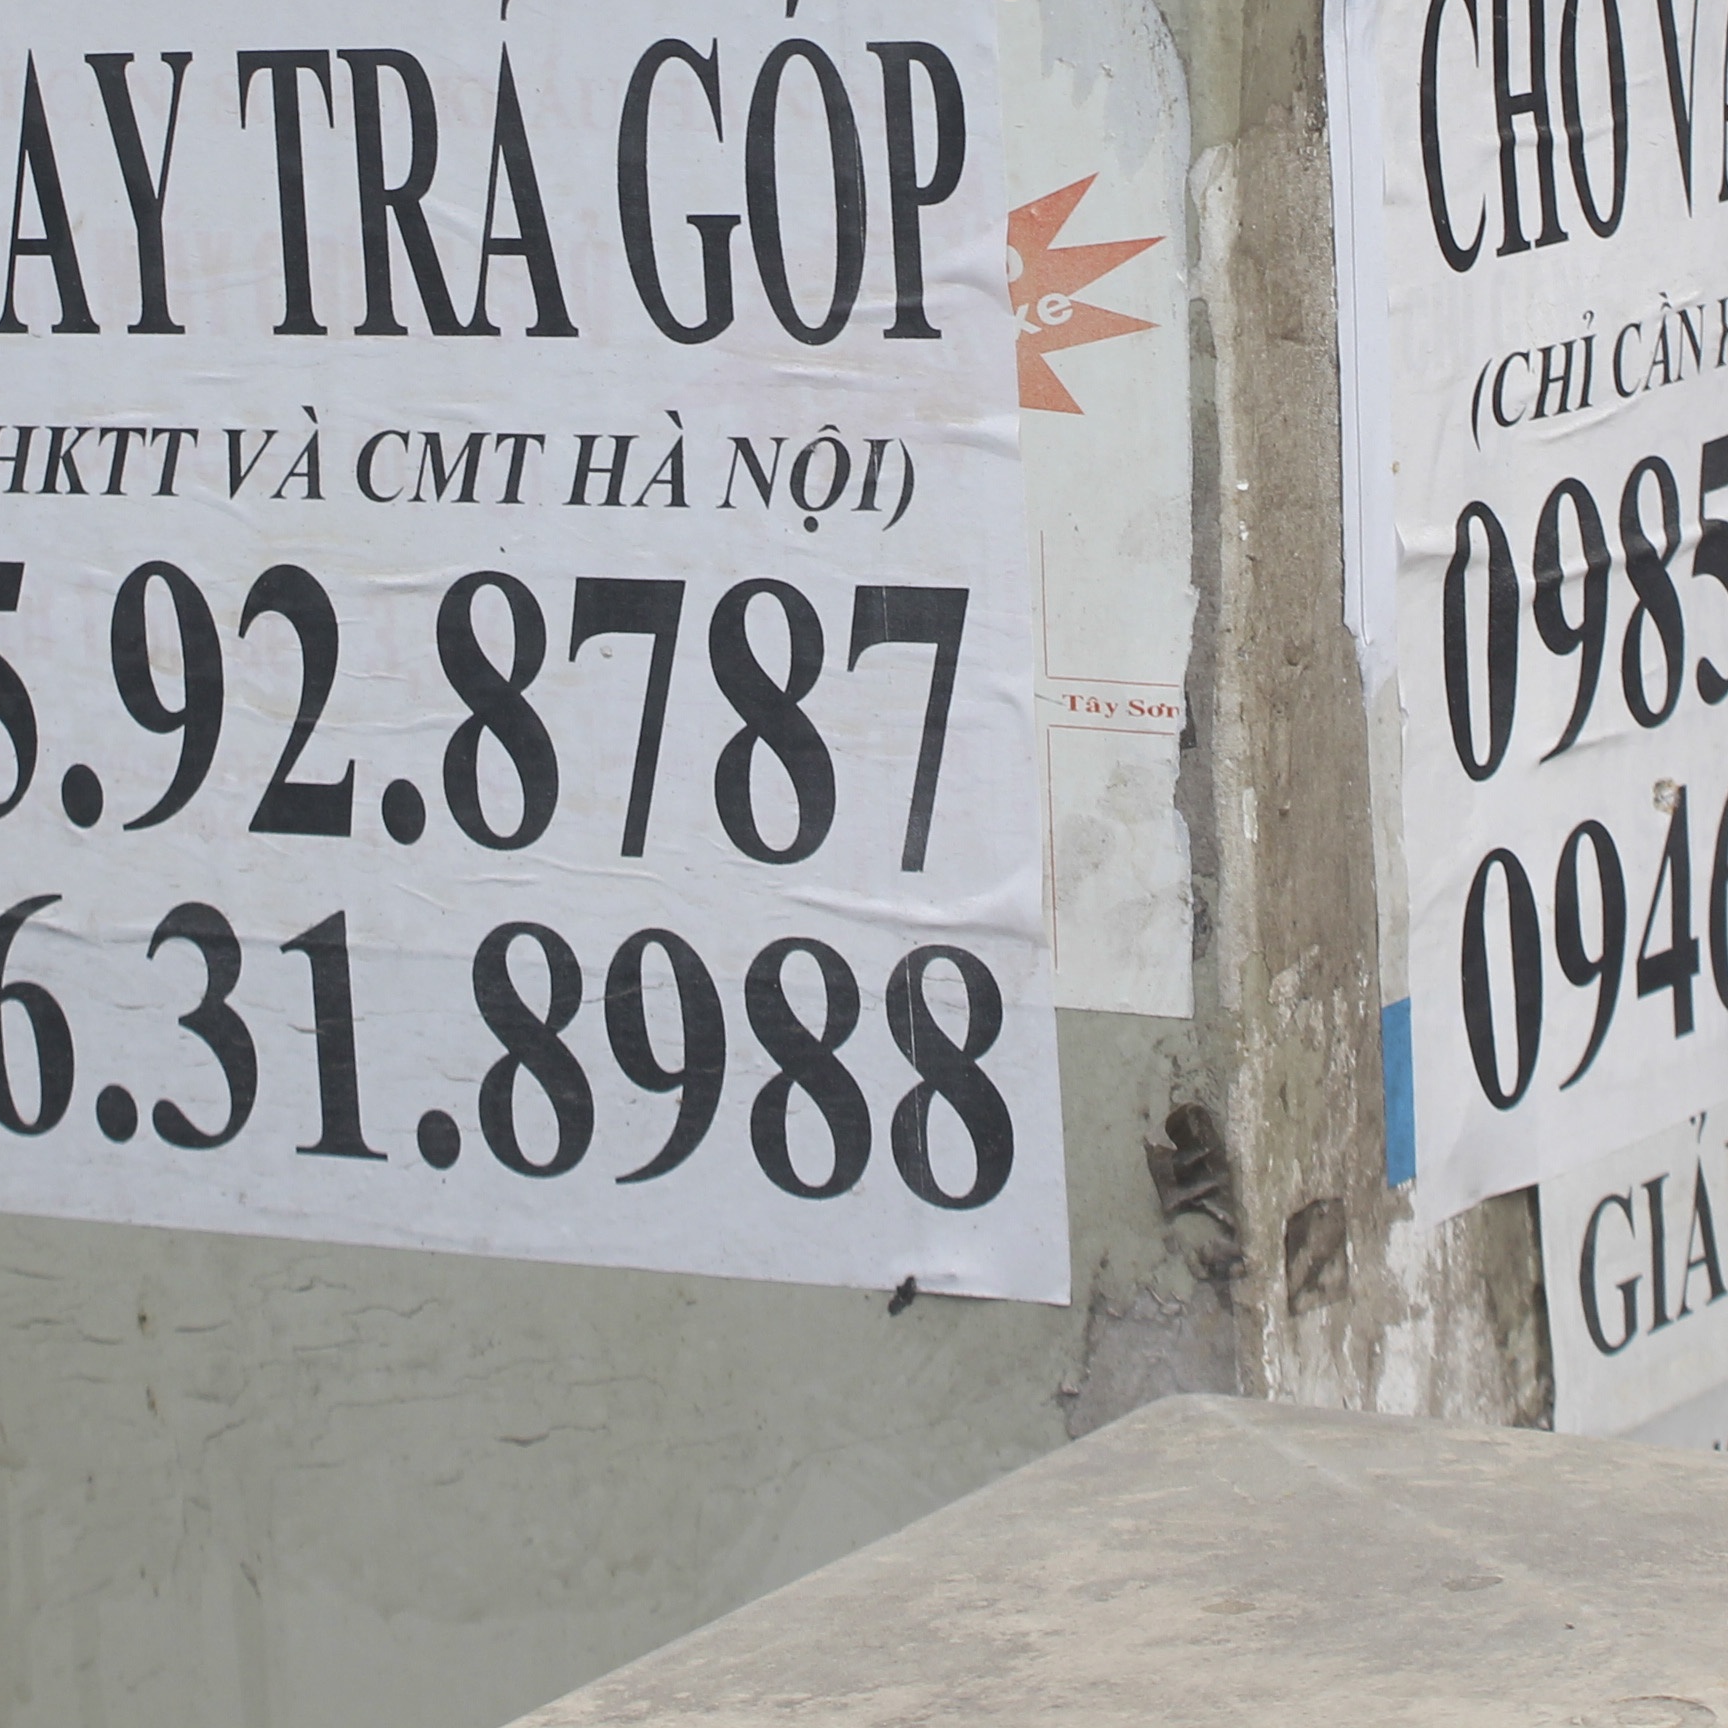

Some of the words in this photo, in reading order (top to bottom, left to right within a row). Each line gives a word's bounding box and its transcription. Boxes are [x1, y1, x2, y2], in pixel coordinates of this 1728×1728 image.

[1470, 310, 1598, 452] (CHỈ
[1611, 292, 1707, 398] CẦN
[224, 406, 326, 501] VÀ
[355, 430, 546, 507] CMT
[562, 409, 691, 513] HÀ
[720, 424, 915, 533] NỘI)
[1062, 694, 1118, 718] Tây
